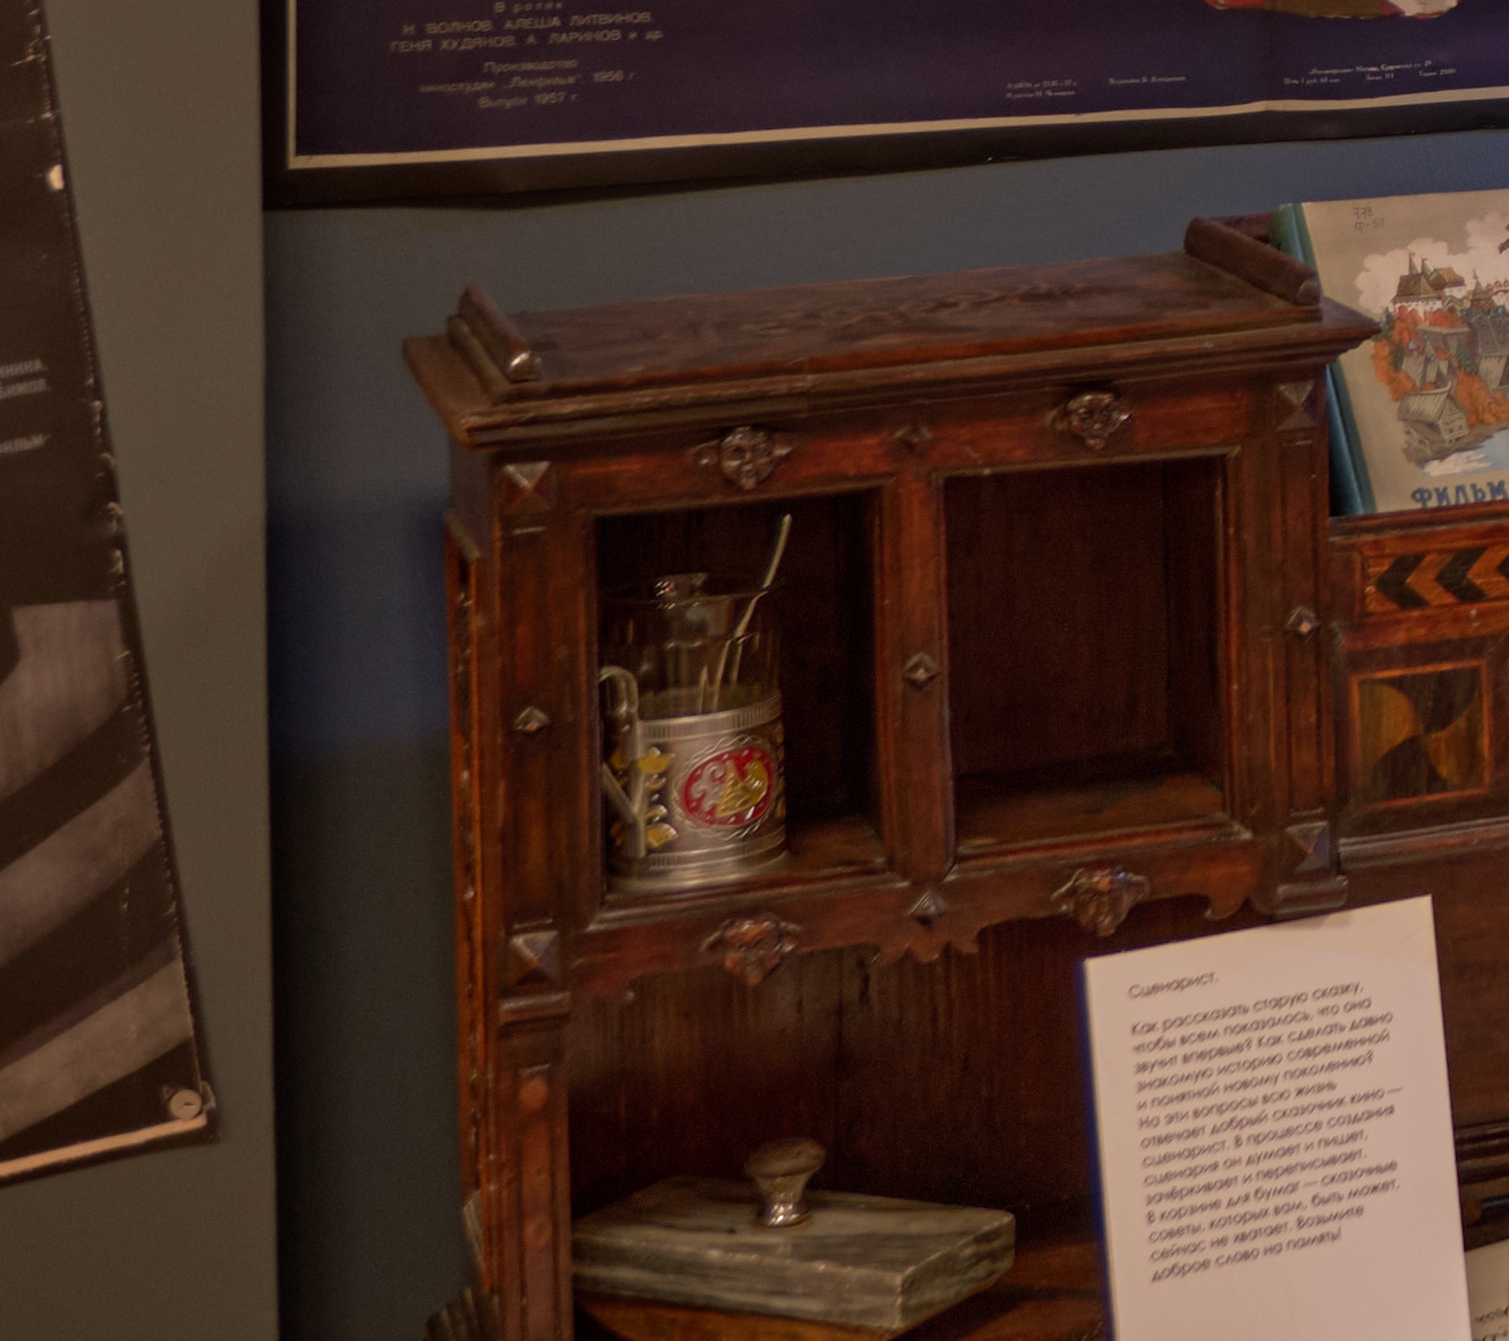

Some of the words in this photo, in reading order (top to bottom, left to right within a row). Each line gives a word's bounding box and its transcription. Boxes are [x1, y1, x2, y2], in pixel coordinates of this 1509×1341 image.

[1131, 1021, 1158, 1037] Как
[1162, 1004, 1250, 1033] рассказать
[1253, 991, 1308, 1014] старую
